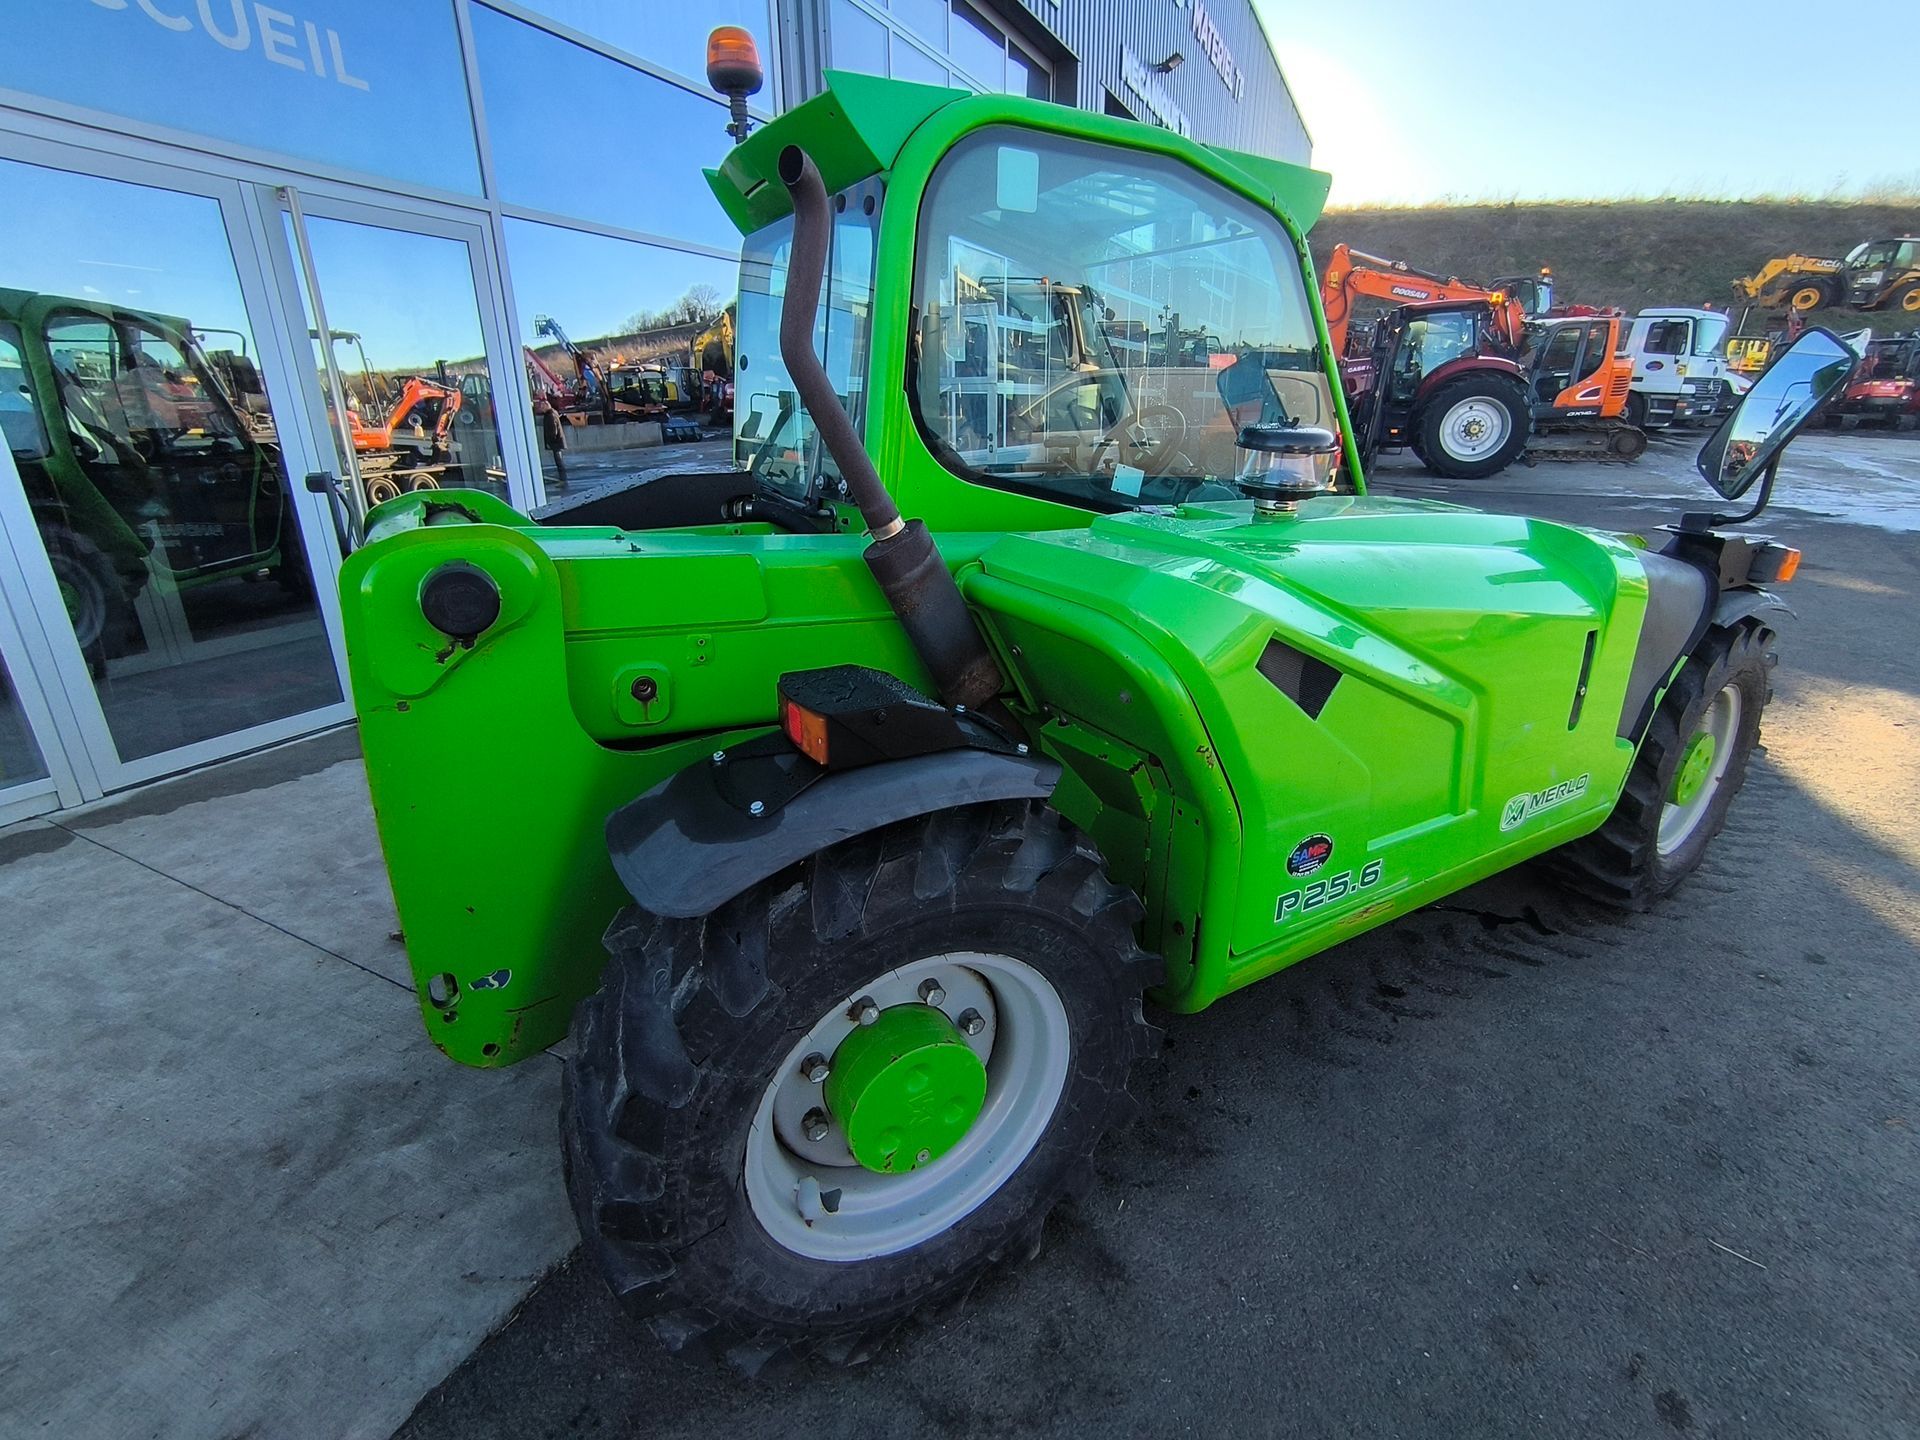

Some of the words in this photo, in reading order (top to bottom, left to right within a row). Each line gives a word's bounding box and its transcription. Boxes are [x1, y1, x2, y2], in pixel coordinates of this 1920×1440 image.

[1392, 287, 1428, 300] DOOSAN
[1347, 365, 1366, 373] CASE
[1528, 773, 1589, 811] MERLO
[1274, 858, 1383, 923] P25.6
